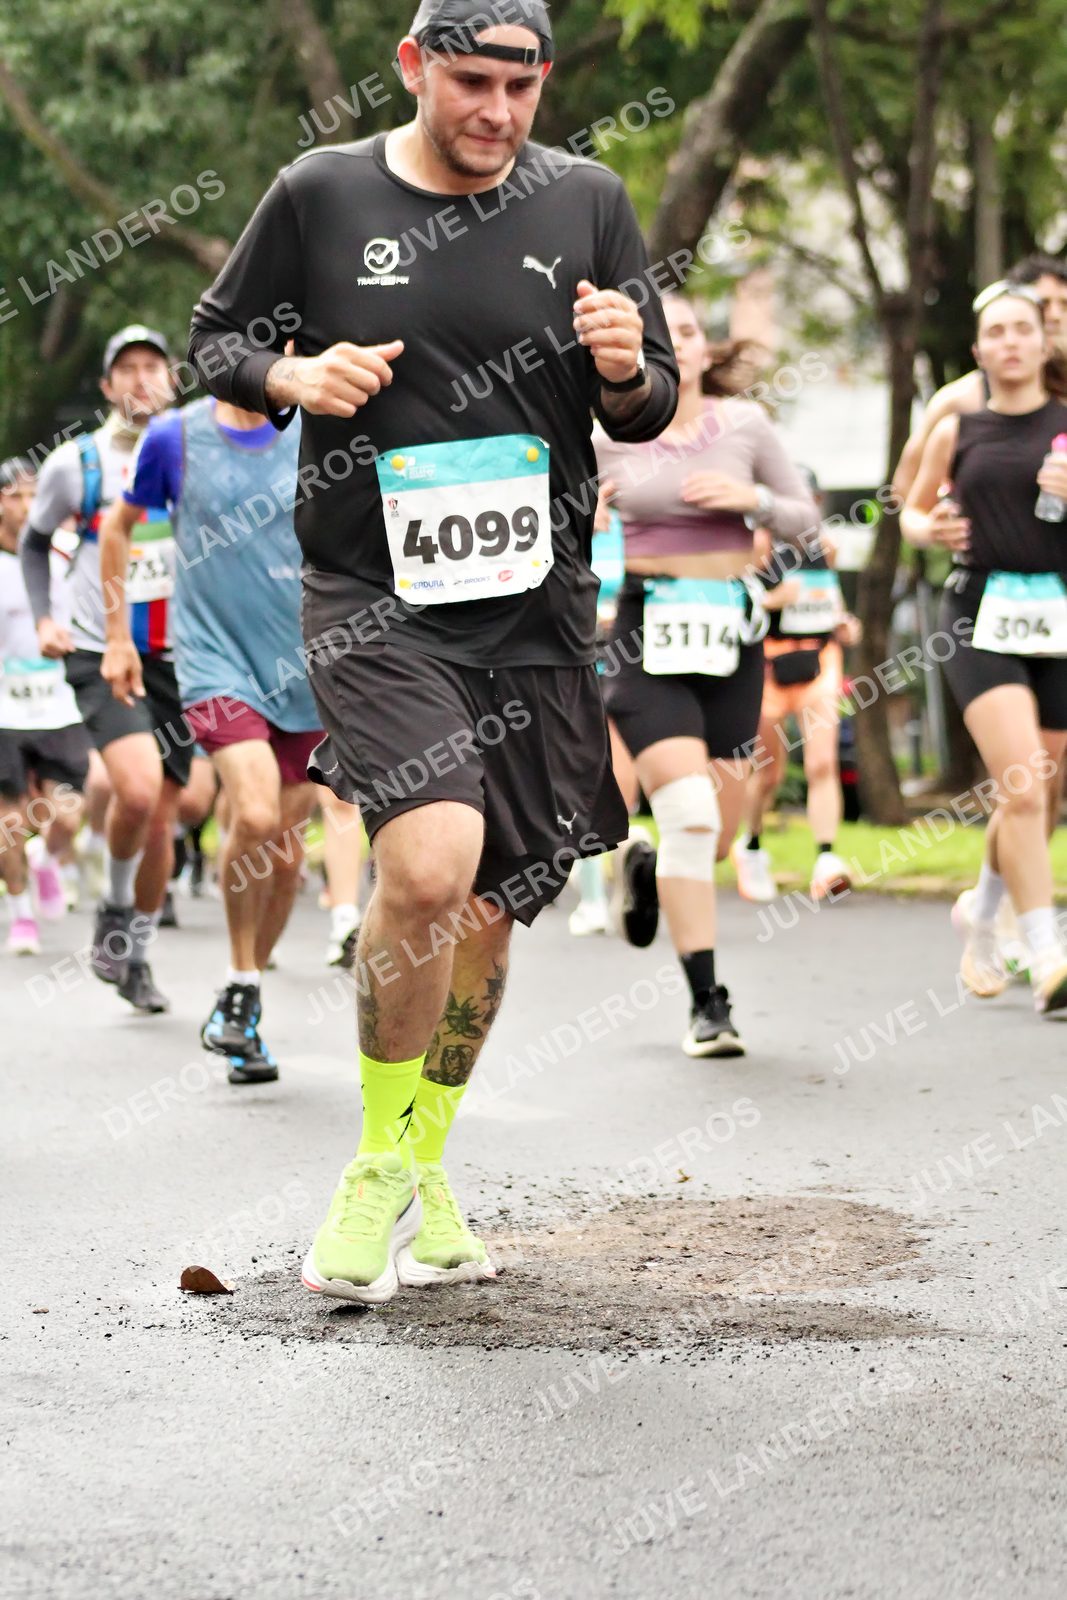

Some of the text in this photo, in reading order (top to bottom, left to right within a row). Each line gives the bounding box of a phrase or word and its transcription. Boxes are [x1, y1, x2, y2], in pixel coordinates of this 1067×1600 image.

[403, 506, 539, 565] 4099
[654, 622, 734, 650] 3114
[994, 616, 1051, 640] 304
